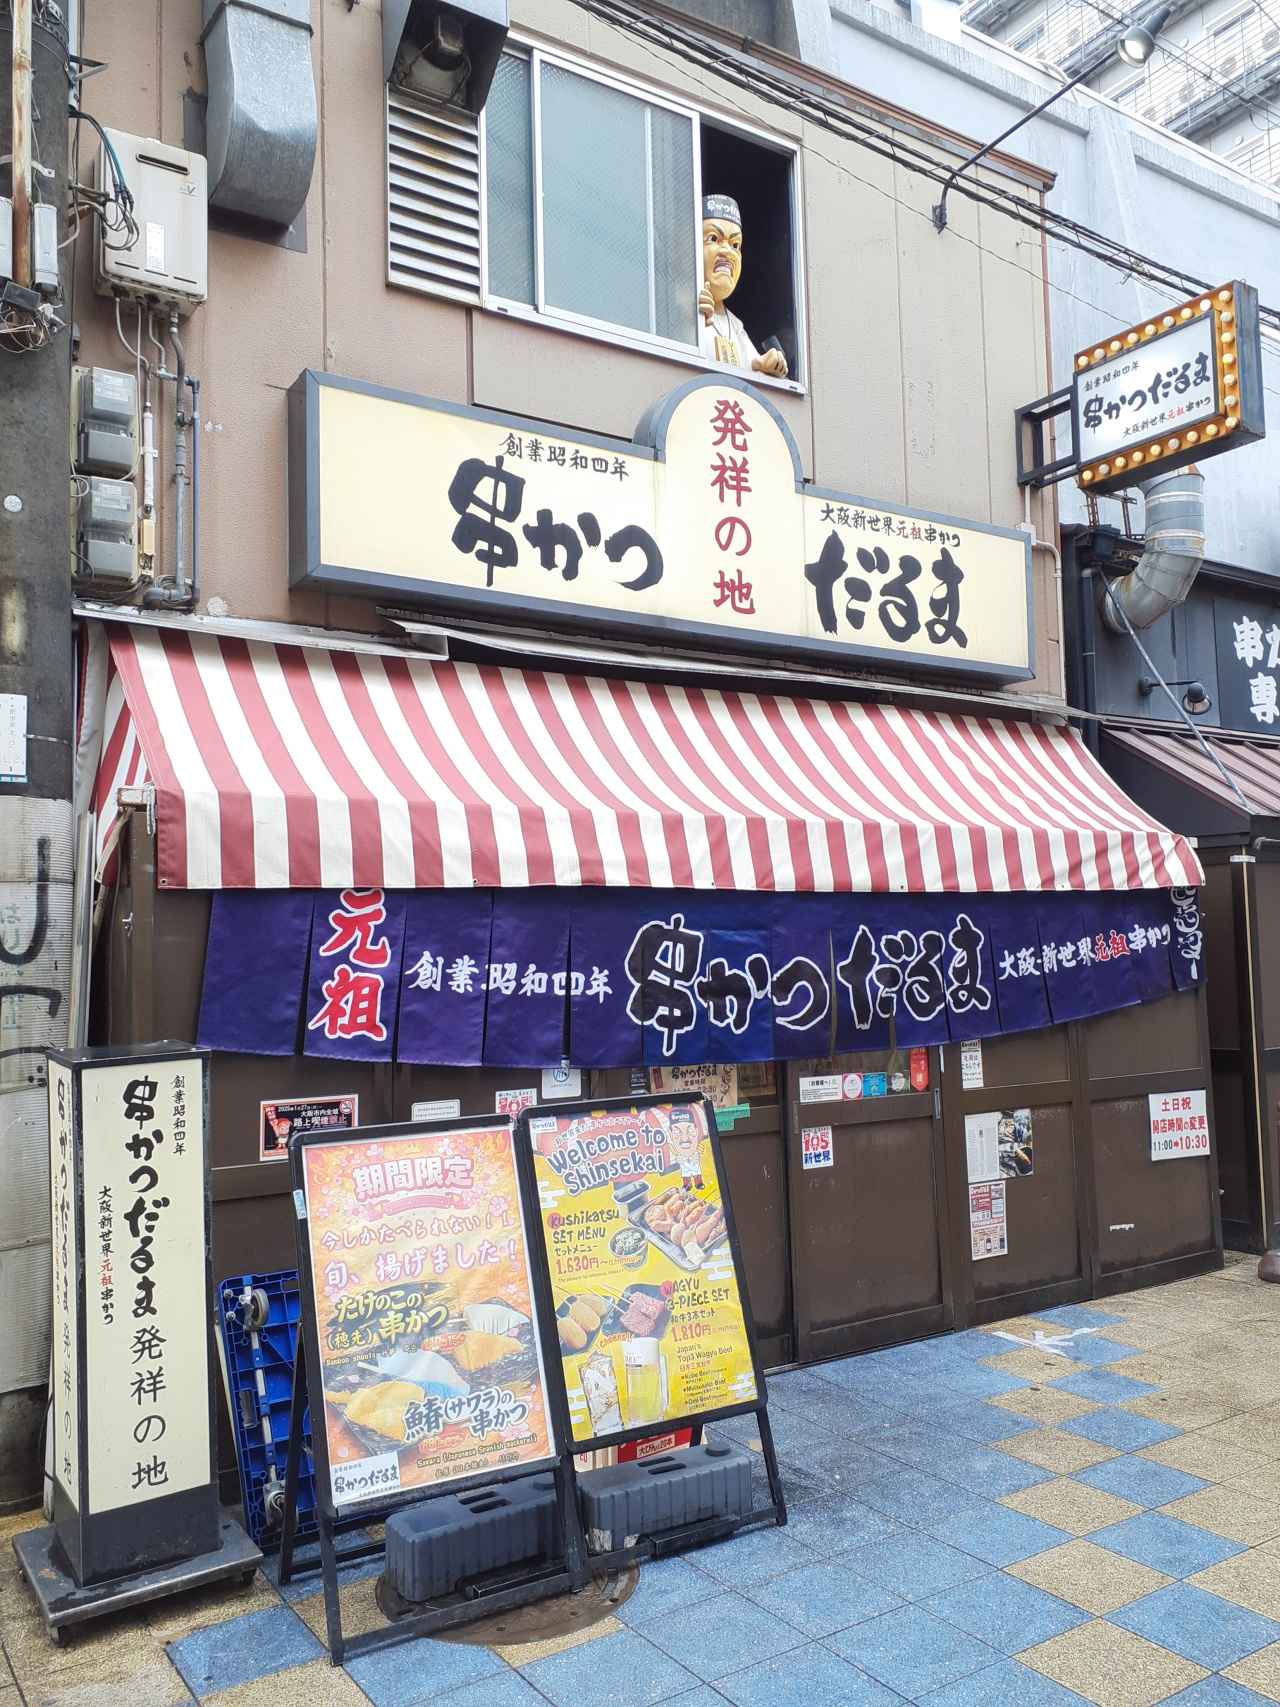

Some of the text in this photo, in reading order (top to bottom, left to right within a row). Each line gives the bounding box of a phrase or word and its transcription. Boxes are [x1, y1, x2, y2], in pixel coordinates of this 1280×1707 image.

[1083, 352, 1211, 433] 串かつだるま
[1084, 361, 1140, 392] 創業昭和四年
[499, 432, 630, 482] 創業昭和四年
[448, 455, 664, 592] 串かつ
[710, 400, 756, 615] 発祥の地
[820, 503, 961, 547] 大阪新世界元祖串かつ
[804, 530, 968, 649] だるま
[308, 888, 391, 1041] 元祖
[405, 950, 615, 1004] 創業昭和四年
[624, 912, 991, 1056] 串かつだるま
[170, 1075, 187, 1156] 創業昭和四年
[1152, 1115, 1206, 1134] 開店時間の変更
[1162, 1097, 1192, 1112] 土日祝
[548, 1129, 638, 1174] Welcome
[642, 1126, 666, 1145] to
[804, 1150, 831, 1164] 新世界
[1153, 1134, 1207, 1152] 11:00 10:30
[353, 1156, 475, 1200] 期間限定
[564, 1150, 664, 1195] Shinsekai
[98, 1186, 114, 1326] 大阪新世界元祖串かつ
[553, 1227, 606, 1244] SET MENU
[336, 1289, 422, 1323] たけのこの
[712, 1288, 731, 1301] SET
[378, 1304, 449, 1344] 串かつ
[471, 1400, 529, 1441] 串かつ
